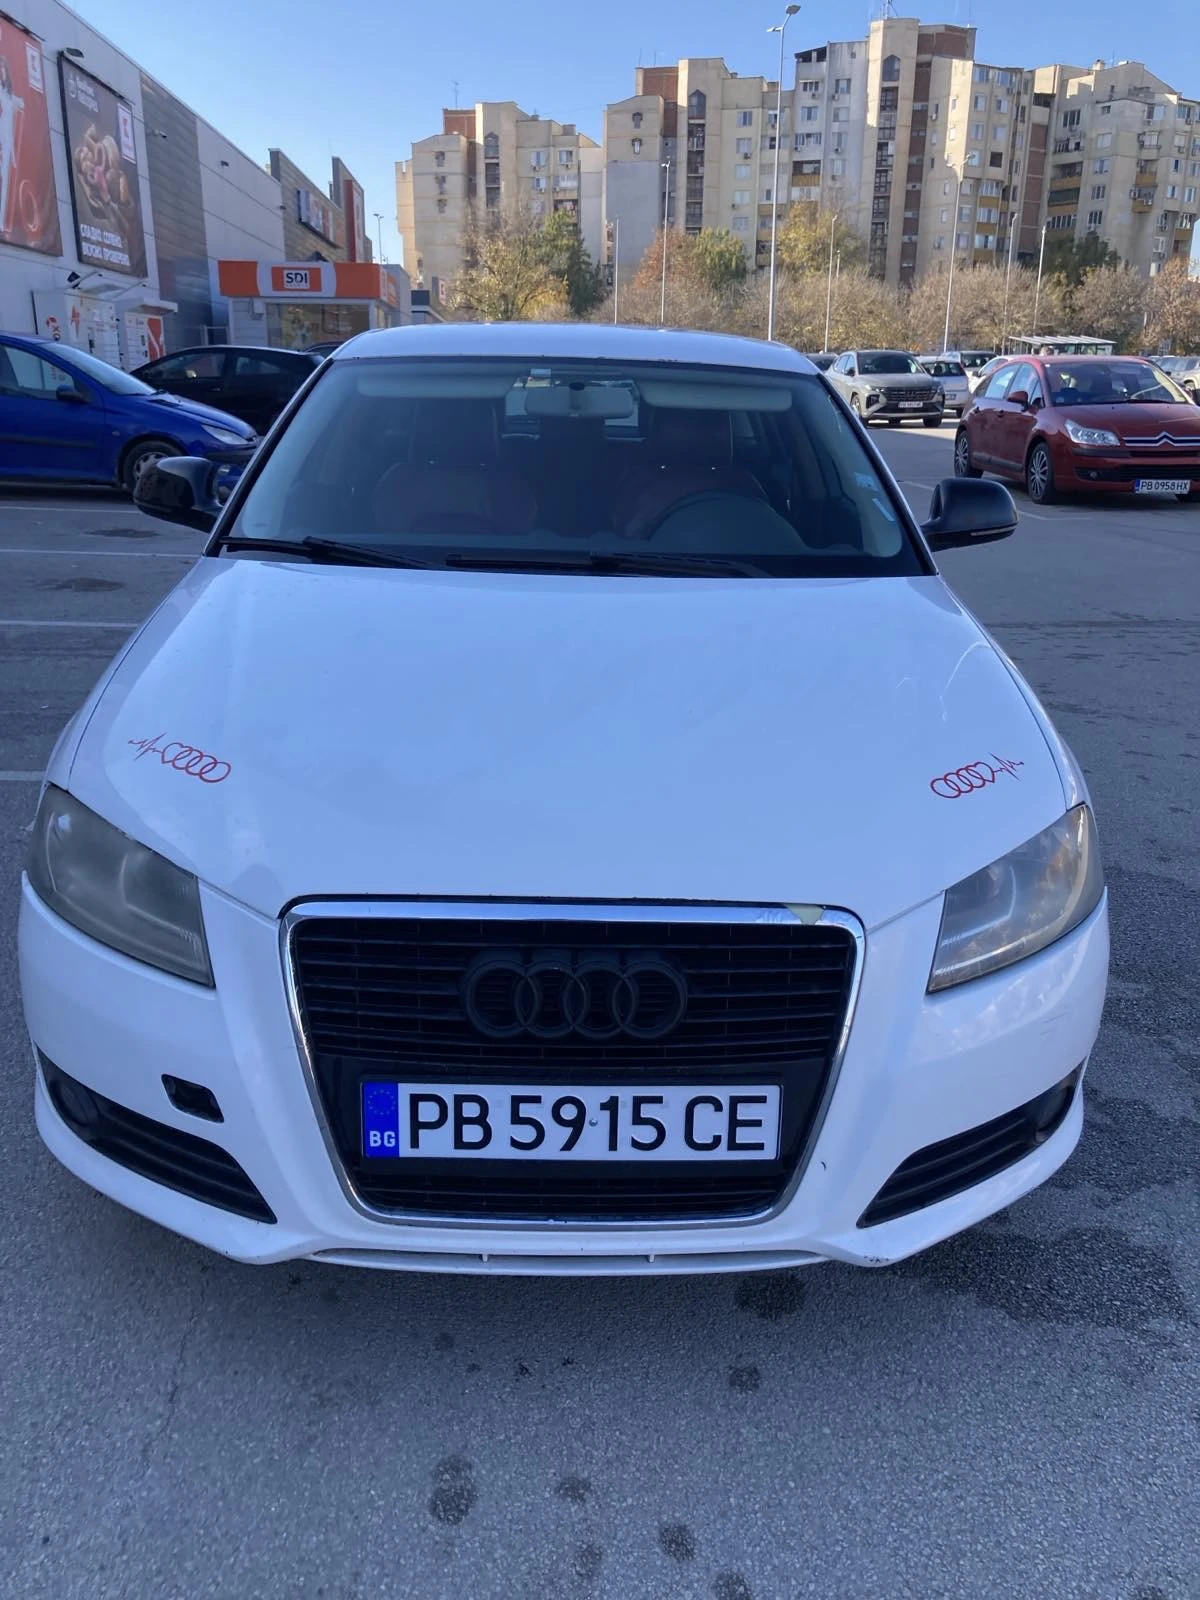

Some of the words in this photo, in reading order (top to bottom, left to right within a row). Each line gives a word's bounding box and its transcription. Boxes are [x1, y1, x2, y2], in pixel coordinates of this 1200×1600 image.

[286, 272, 308, 284] SDI
[1141, 481, 1153, 490] PB
[1154, 481, 1175, 490] 0958
[1176, 481, 1189, 490] HX
[409, 1093, 493, 1150] PB
[510, 1094, 667, 1152] 5915
[684, 1095, 769, 1152] CE
[370, 1131, 396, 1147] BG
